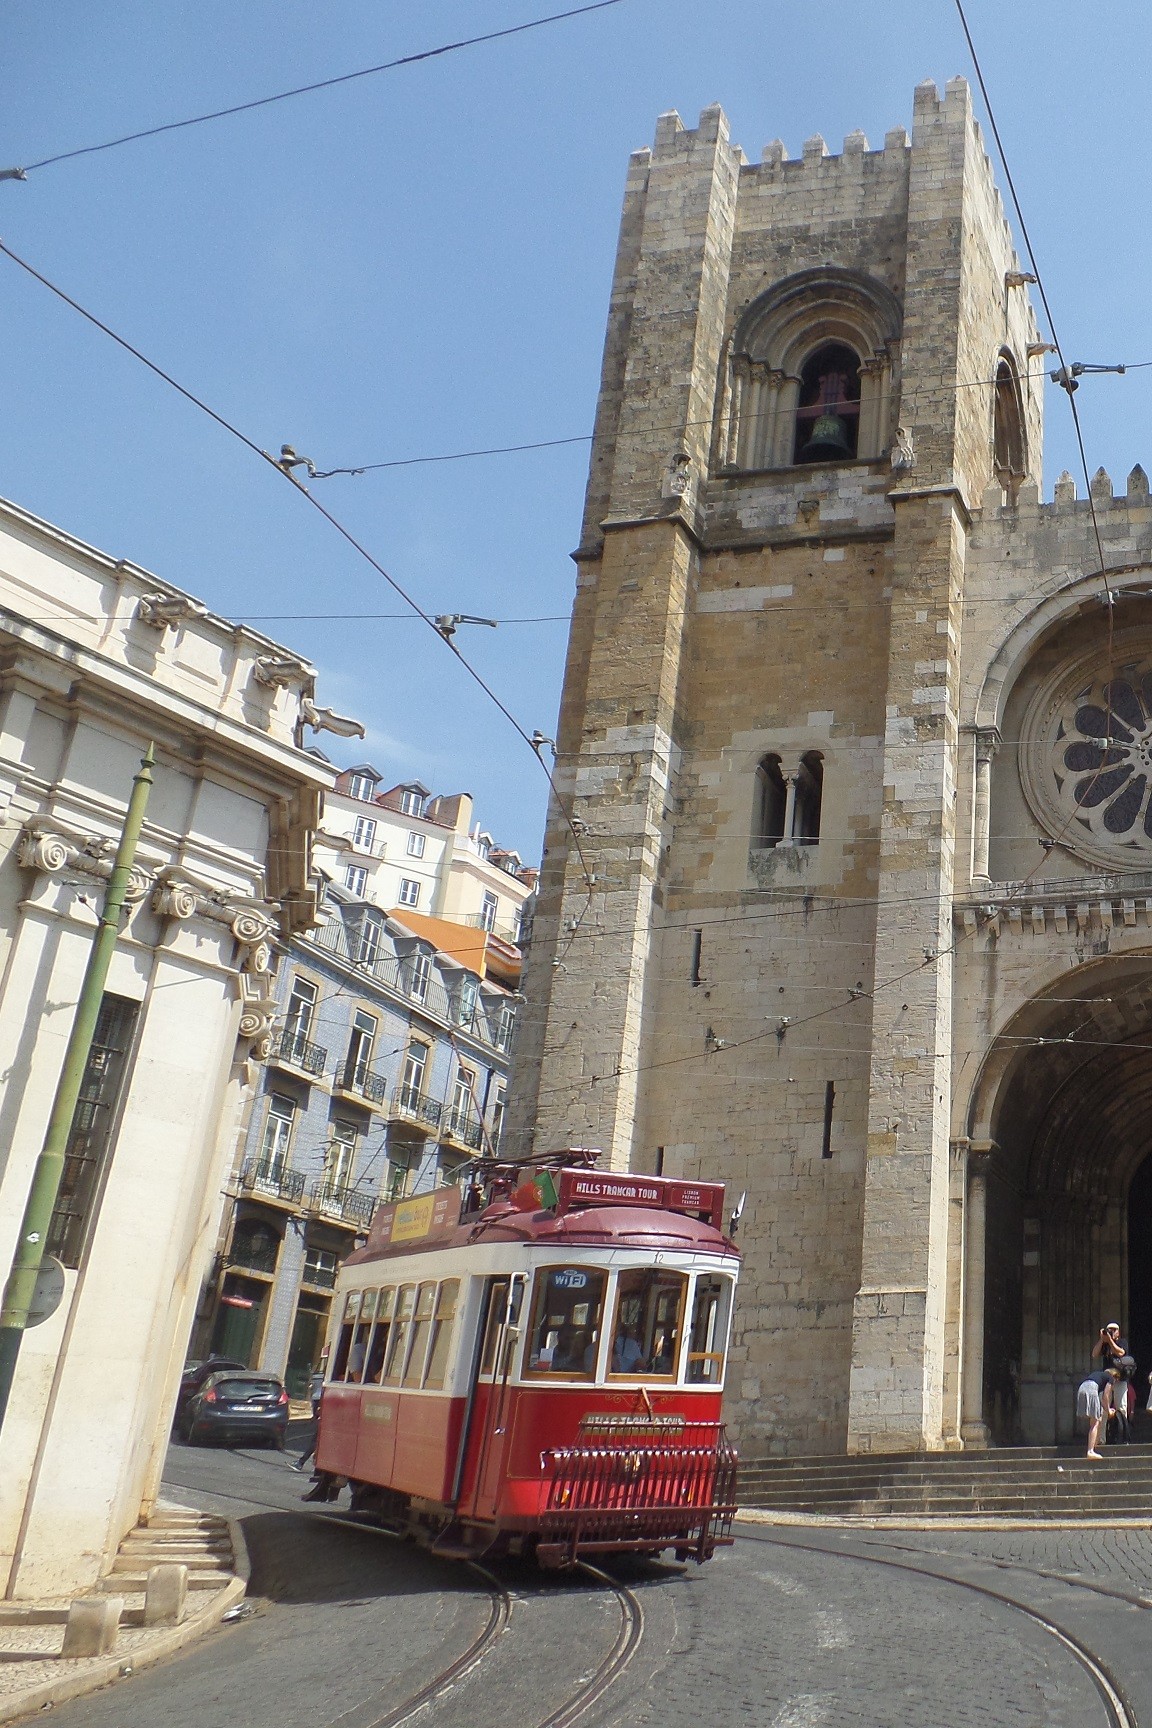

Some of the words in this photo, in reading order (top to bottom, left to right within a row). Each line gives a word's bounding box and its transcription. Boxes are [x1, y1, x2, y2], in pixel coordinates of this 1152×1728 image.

[576, 1182, 600, 1195] HILLS
[602, 1184, 636, 1198] TRAMCAR
[638, 1188, 658, 1200] TOUR
